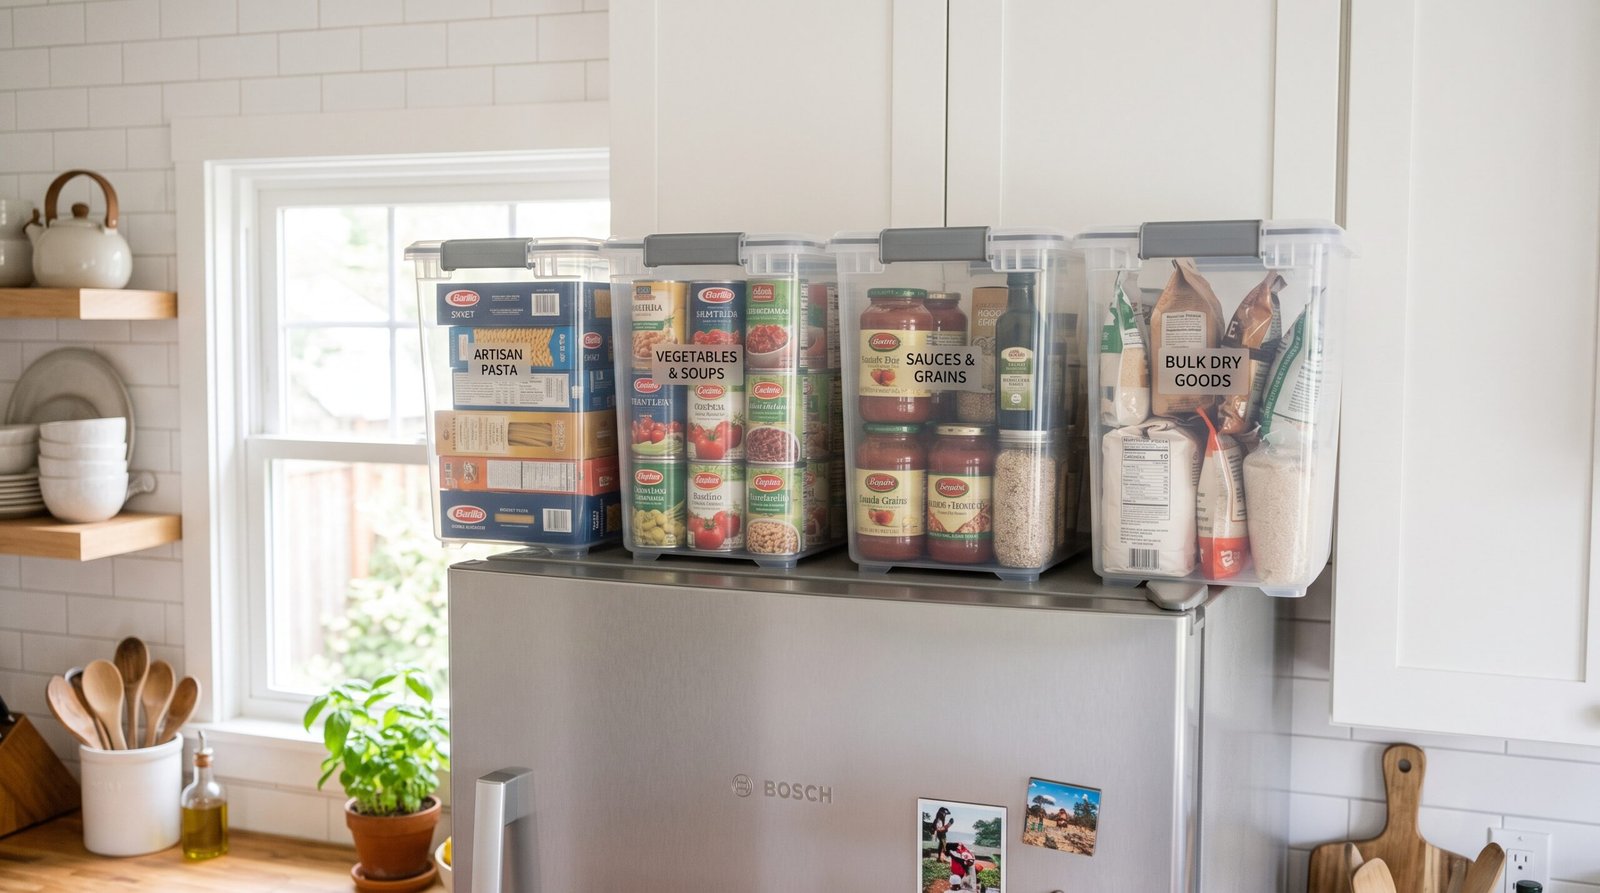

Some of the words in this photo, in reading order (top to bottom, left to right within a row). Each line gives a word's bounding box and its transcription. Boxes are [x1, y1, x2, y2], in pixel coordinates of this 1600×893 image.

[474, 348, 523, 361] ARTISAN
[656, 350, 738, 363] VEGETABLES
[906, 352, 961, 366] SAUCES
[964, 353, 975, 366] &
[1165, 355, 1206, 369] BULK
[1210, 356, 1242, 370] DRY
[481, 364, 518, 376] PASTA
[668, 367, 678, 379] &
[681, 367, 725, 380] SOUPS
[914, 370, 967, 384] GRAINS
[1174, 374, 1231, 388] GOODS
[454, 508, 483, 519] Barilla
[764, 780, 832, 804] BOSCH
